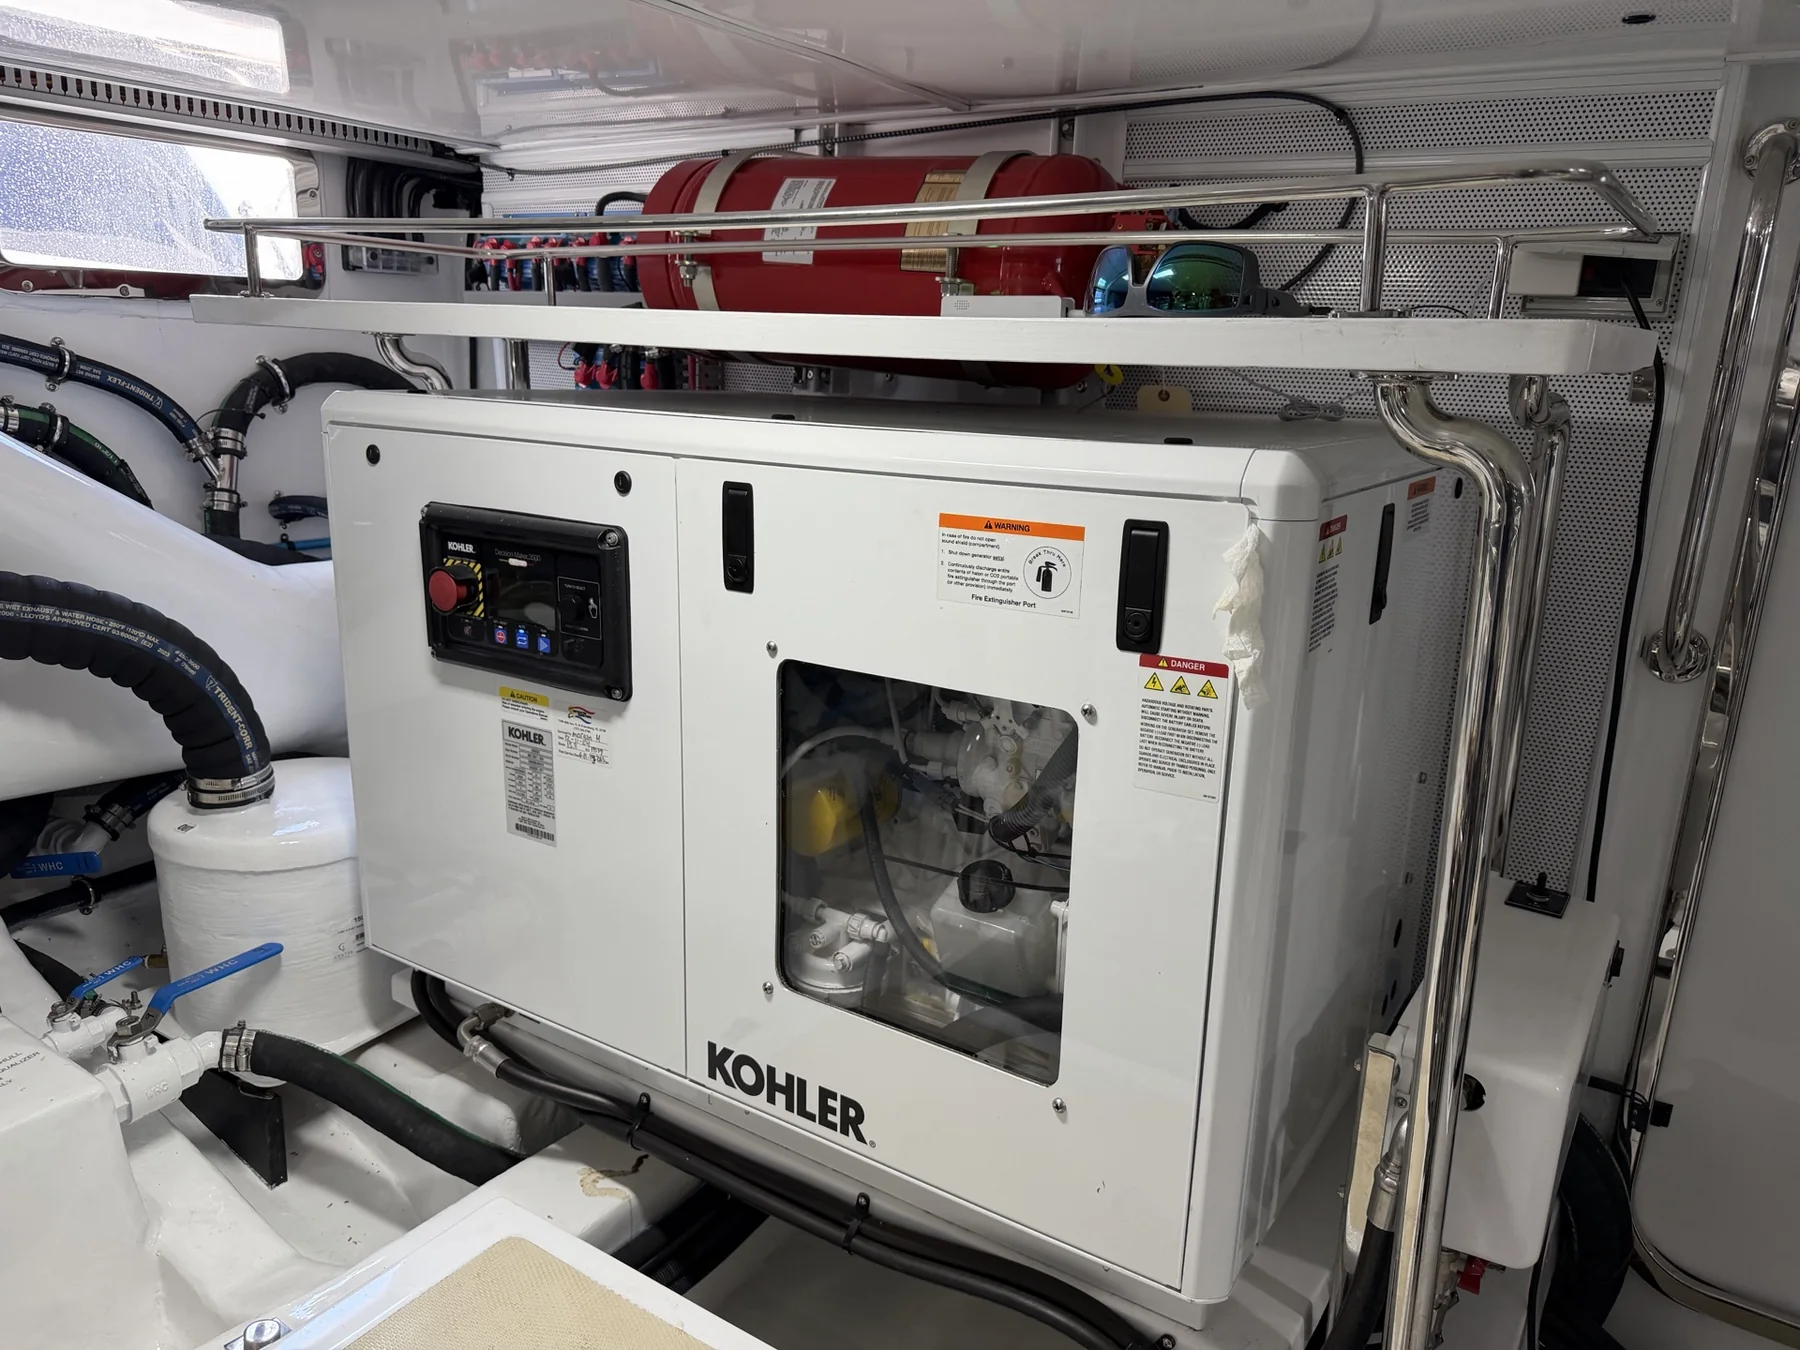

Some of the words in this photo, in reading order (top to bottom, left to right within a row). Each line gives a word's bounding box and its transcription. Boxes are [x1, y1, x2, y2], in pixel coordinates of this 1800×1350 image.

[107, 374, 154, 402] TRIDENT-FLEX
[994, 522, 1030, 532] WARNING
[448, 541, 474, 553] KOHLER
[1056, 555, 1066, 568] Here
[971, 594, 982, 602] Fire
[984, 596, 1021, 606] Extinguisher
[22, 606, 54, 614] EXHAUST
[62, 611, 85, 619] WATER
[86, 616, 104, 625] HOSE
[52, 616, 90, 627] APPROVED
[92, 624, 111, 632] CERT
[1170, 659, 1205, 671] DANGER
[516, 693, 537, 702] CAUTION
[214, 686, 253, 749] TRIDENT-CORR
[508, 726, 544, 746] KOHLER
[38, 862, 63, 872] WHC
[104, 960, 131, 975] WHC
[205, 959, 238, 974] WHC
[708, 1040, 868, 1145] KOHLER
